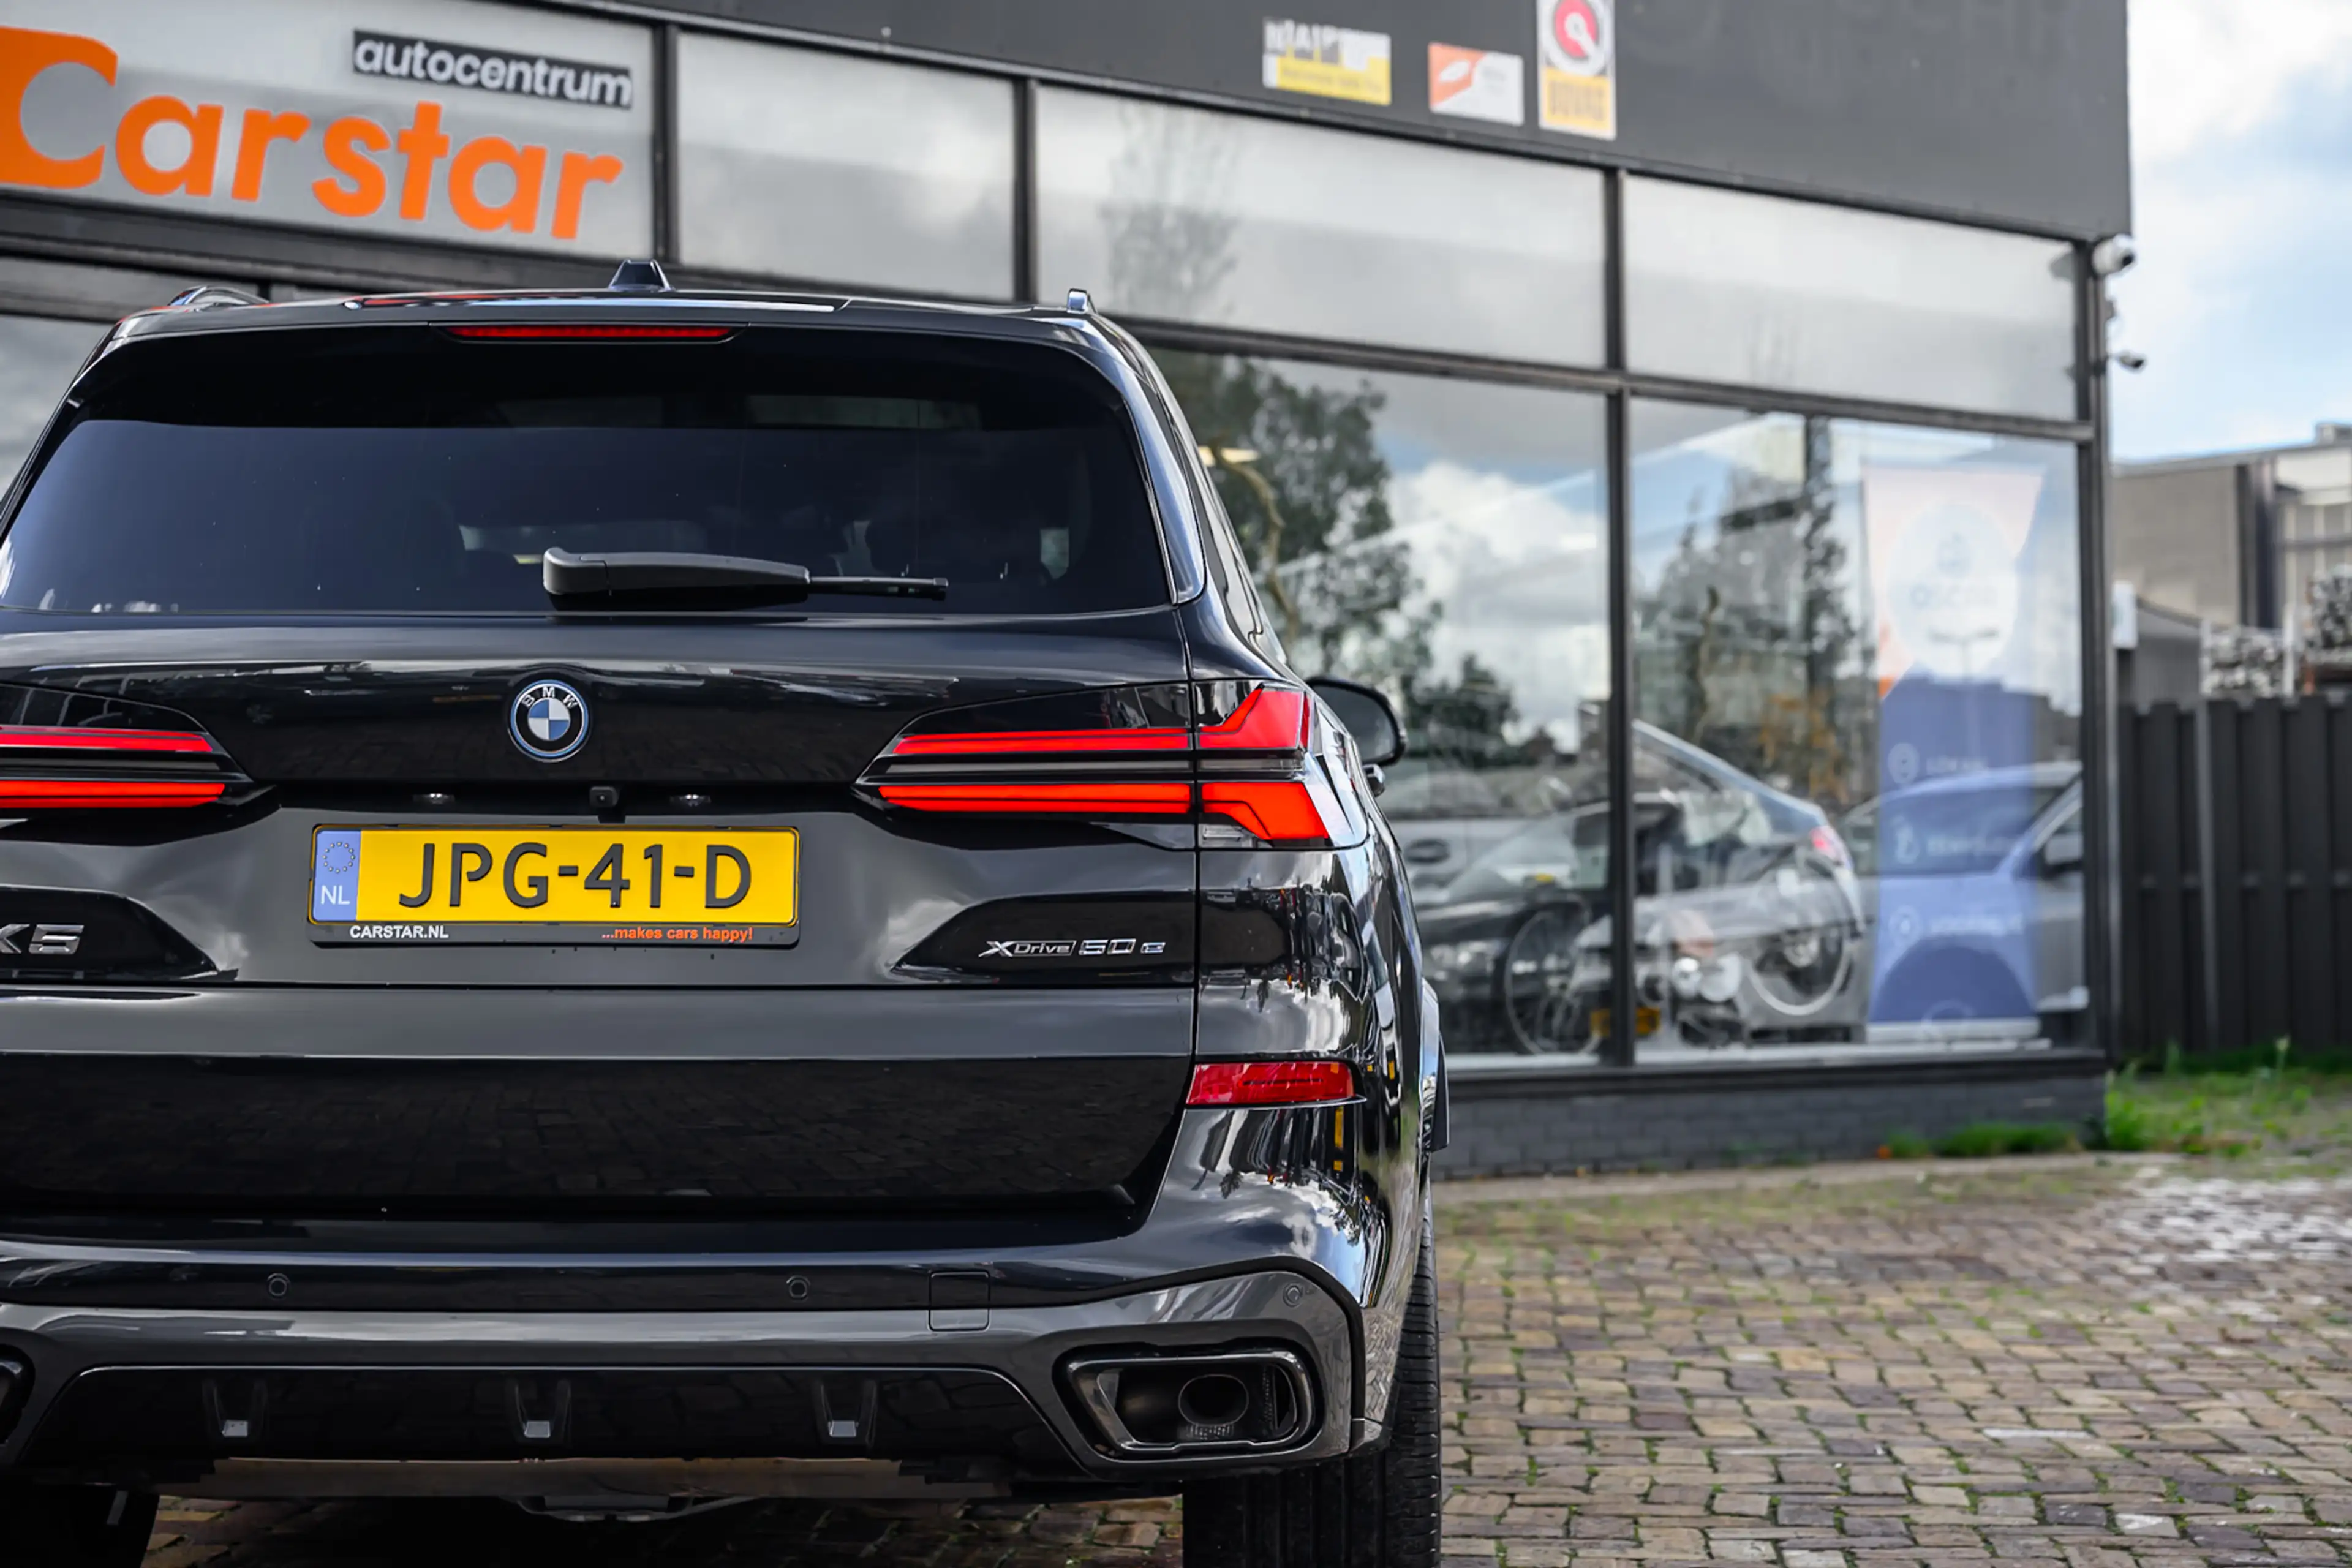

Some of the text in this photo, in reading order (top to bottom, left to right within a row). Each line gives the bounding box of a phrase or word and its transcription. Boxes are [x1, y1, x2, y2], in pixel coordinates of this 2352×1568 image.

[355, 38, 631, 106] autocentrum
[0, 26, 623, 239] Carstar
[521, 685, 578, 709] BMW
[399, 842, 752, 909] JPG-41-D
[320, 886, 350, 906] NL
[349, 925, 449, 938] CARSTAR.NL
[666, 928, 699, 940] cars
[702, 926, 753, 943] happy!
